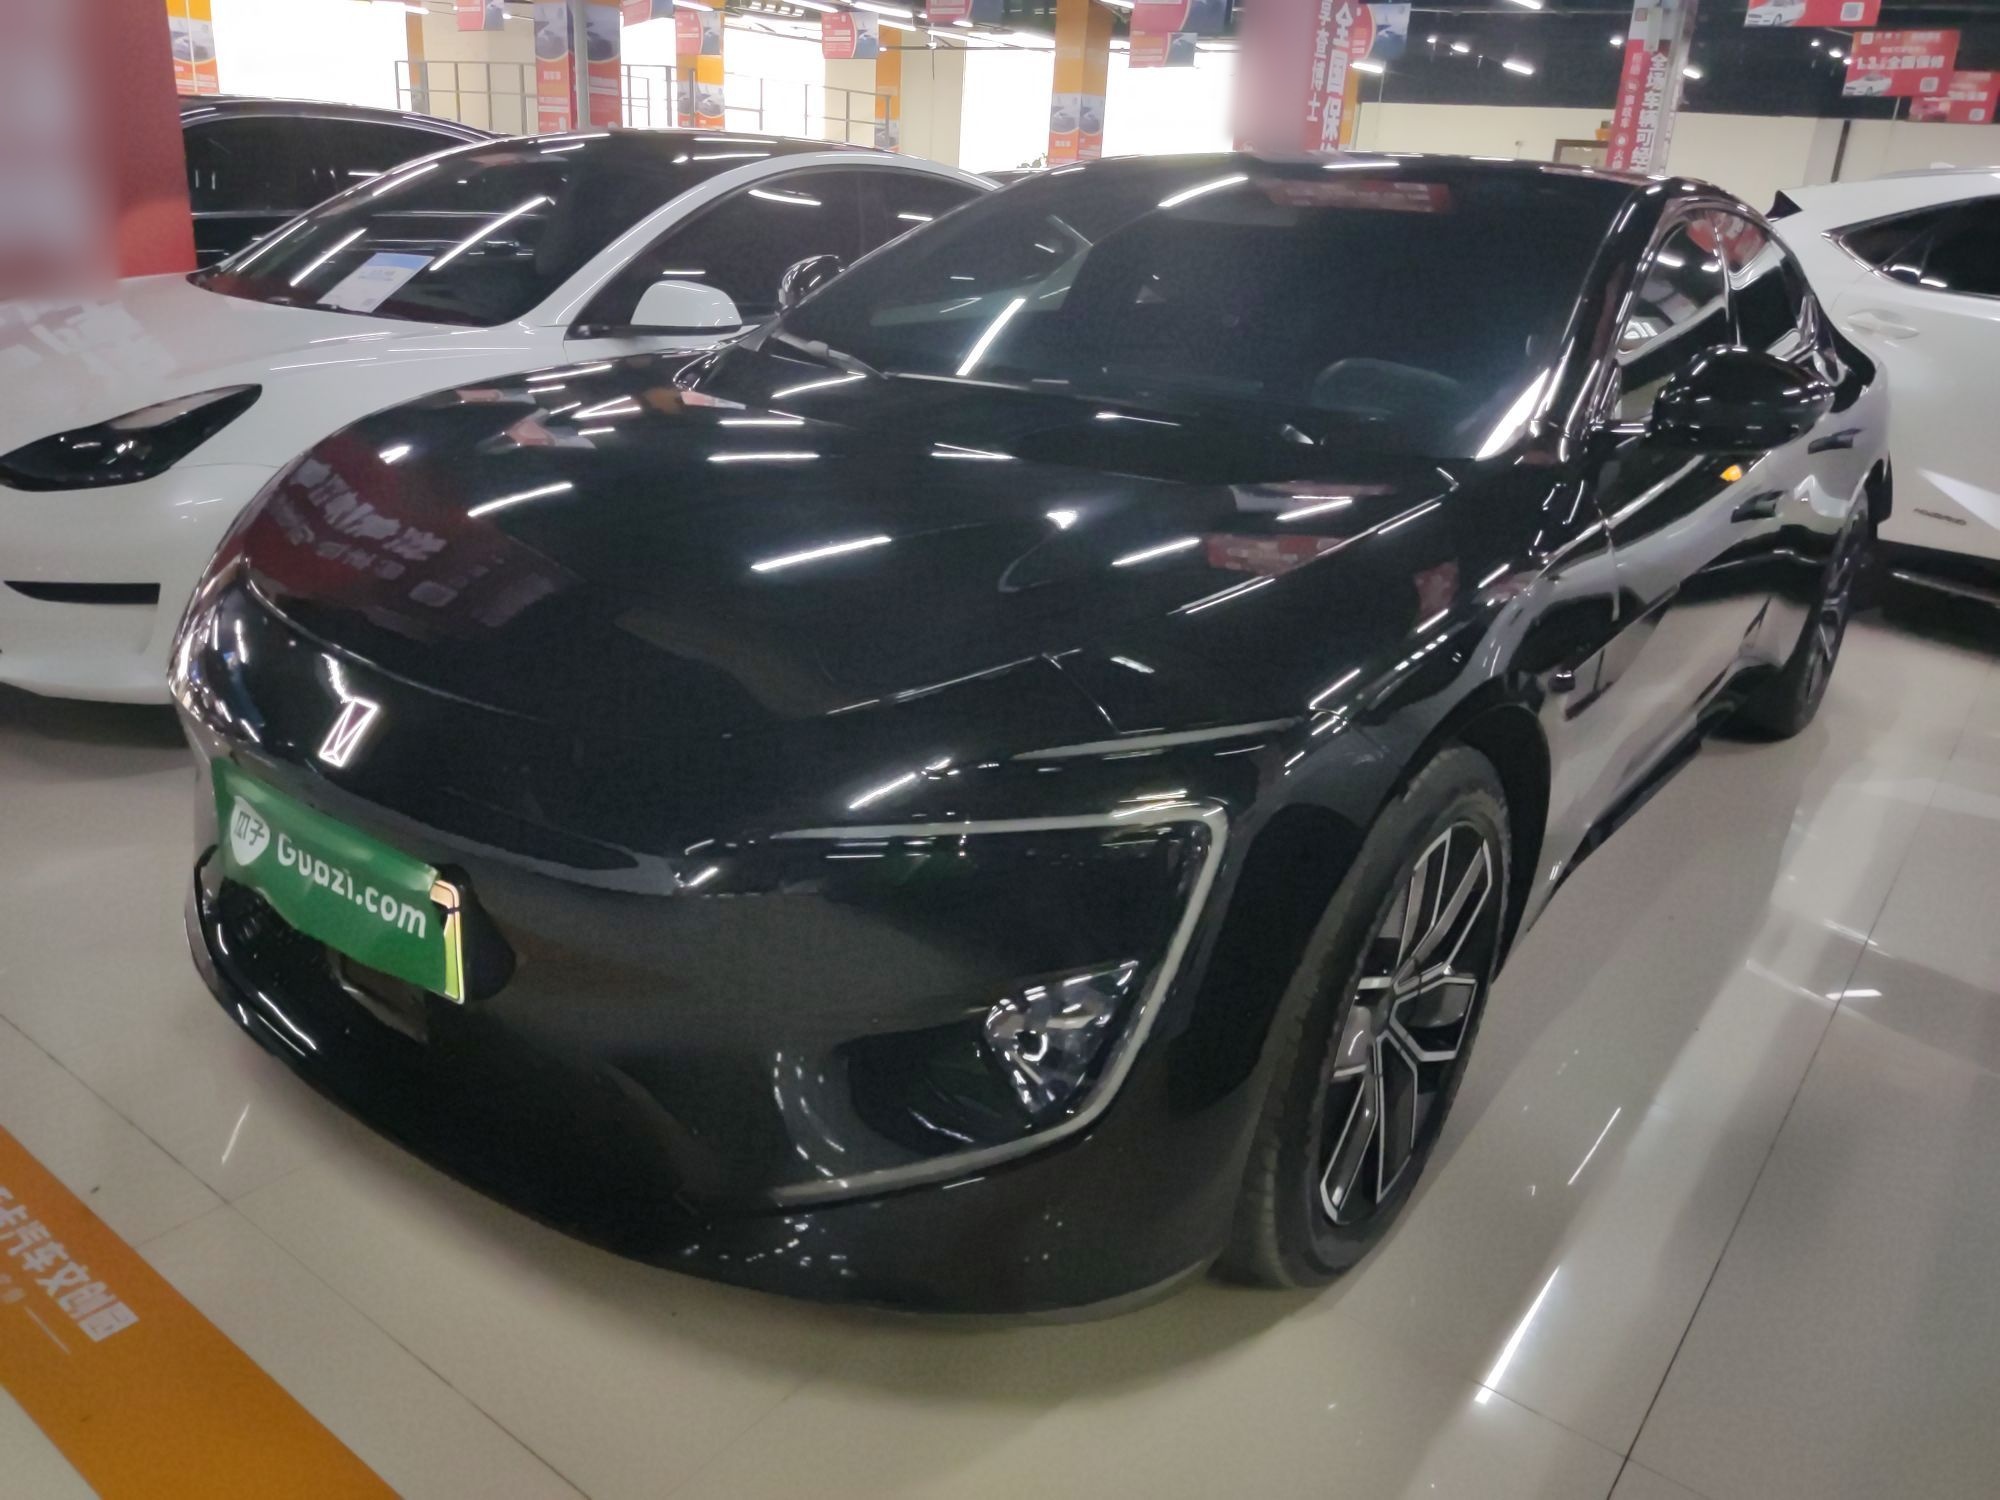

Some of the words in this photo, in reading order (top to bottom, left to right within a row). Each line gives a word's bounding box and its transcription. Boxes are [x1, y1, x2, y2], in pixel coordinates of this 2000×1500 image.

[233, 810, 265, 846] 瓜子
[277, 832, 427, 939] Guazi.com
[0, 1186, 139, 1343] 卡汽车文创园
